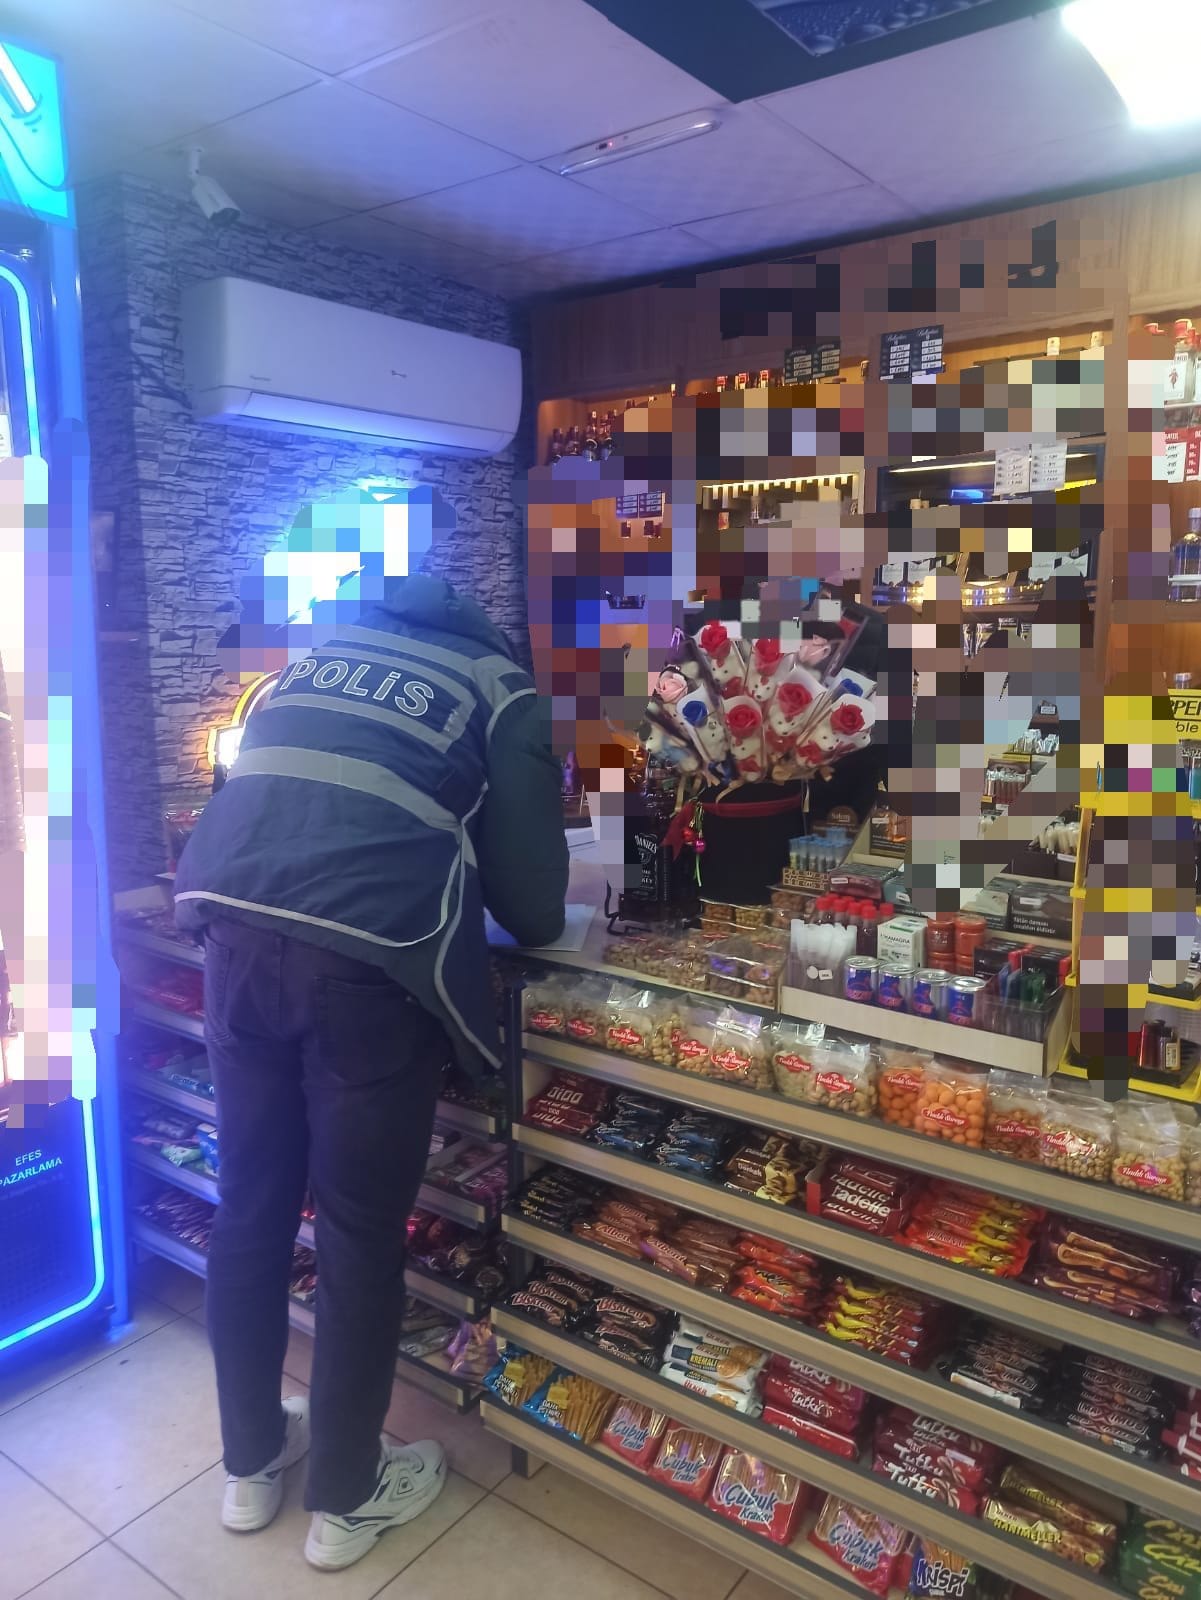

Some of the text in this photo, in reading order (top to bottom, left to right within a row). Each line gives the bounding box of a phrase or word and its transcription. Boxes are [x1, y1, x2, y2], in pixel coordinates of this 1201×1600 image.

[0, 1156, 63, 1187] AZARLAMA
[15, 1149, 42, 1167] EFES
[725, 1484, 778, 1512] Çubuk
[828, 1524, 883, 1560] Çubuk
